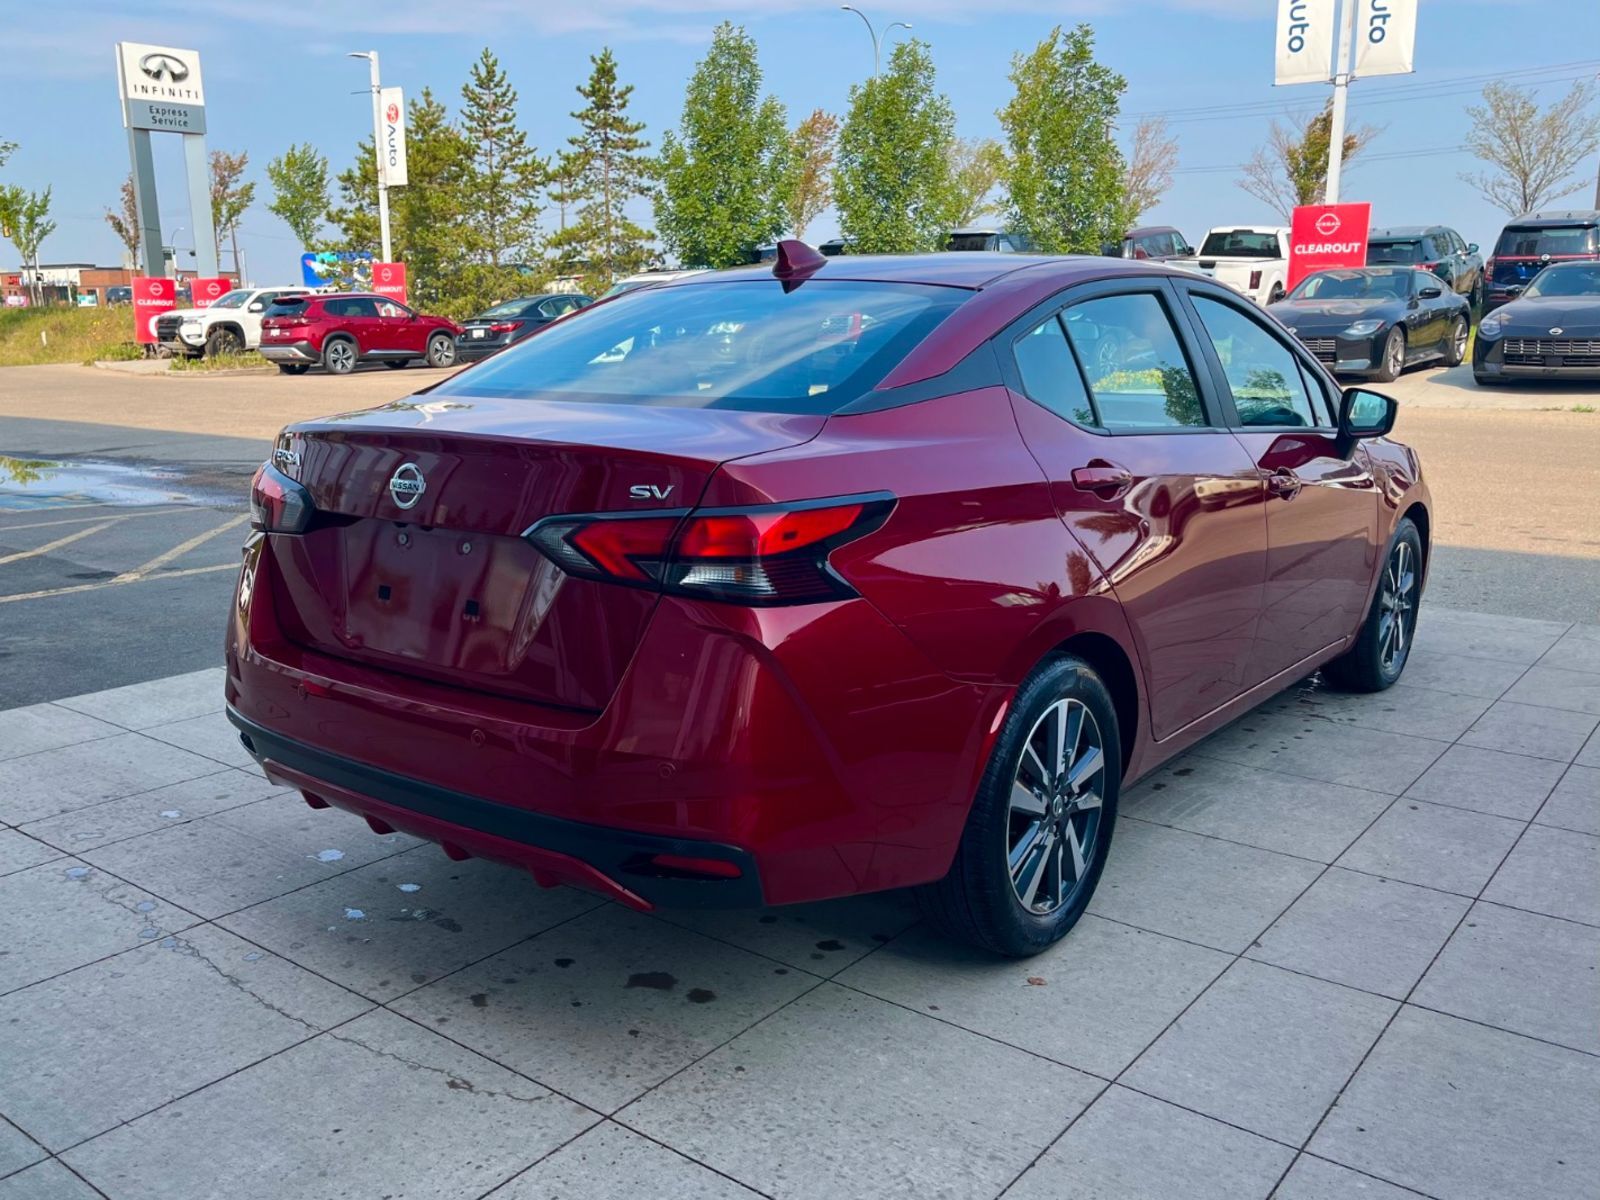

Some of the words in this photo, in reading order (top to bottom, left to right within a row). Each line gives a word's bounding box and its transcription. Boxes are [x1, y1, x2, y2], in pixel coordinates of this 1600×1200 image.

[1287, 0, 1310, 53] uto
[1368, 0, 1392, 44] uto
[134, 84, 198, 99] INFINITI
[149, 105, 188, 117] Express
[151, 115, 188, 127] Service
[387, 124, 397, 167] Auto
[1294, 242, 1361, 254] CLEAROUT
[137, 299, 174, 307] CLEAROUT
[629, 484, 675, 500] SV
